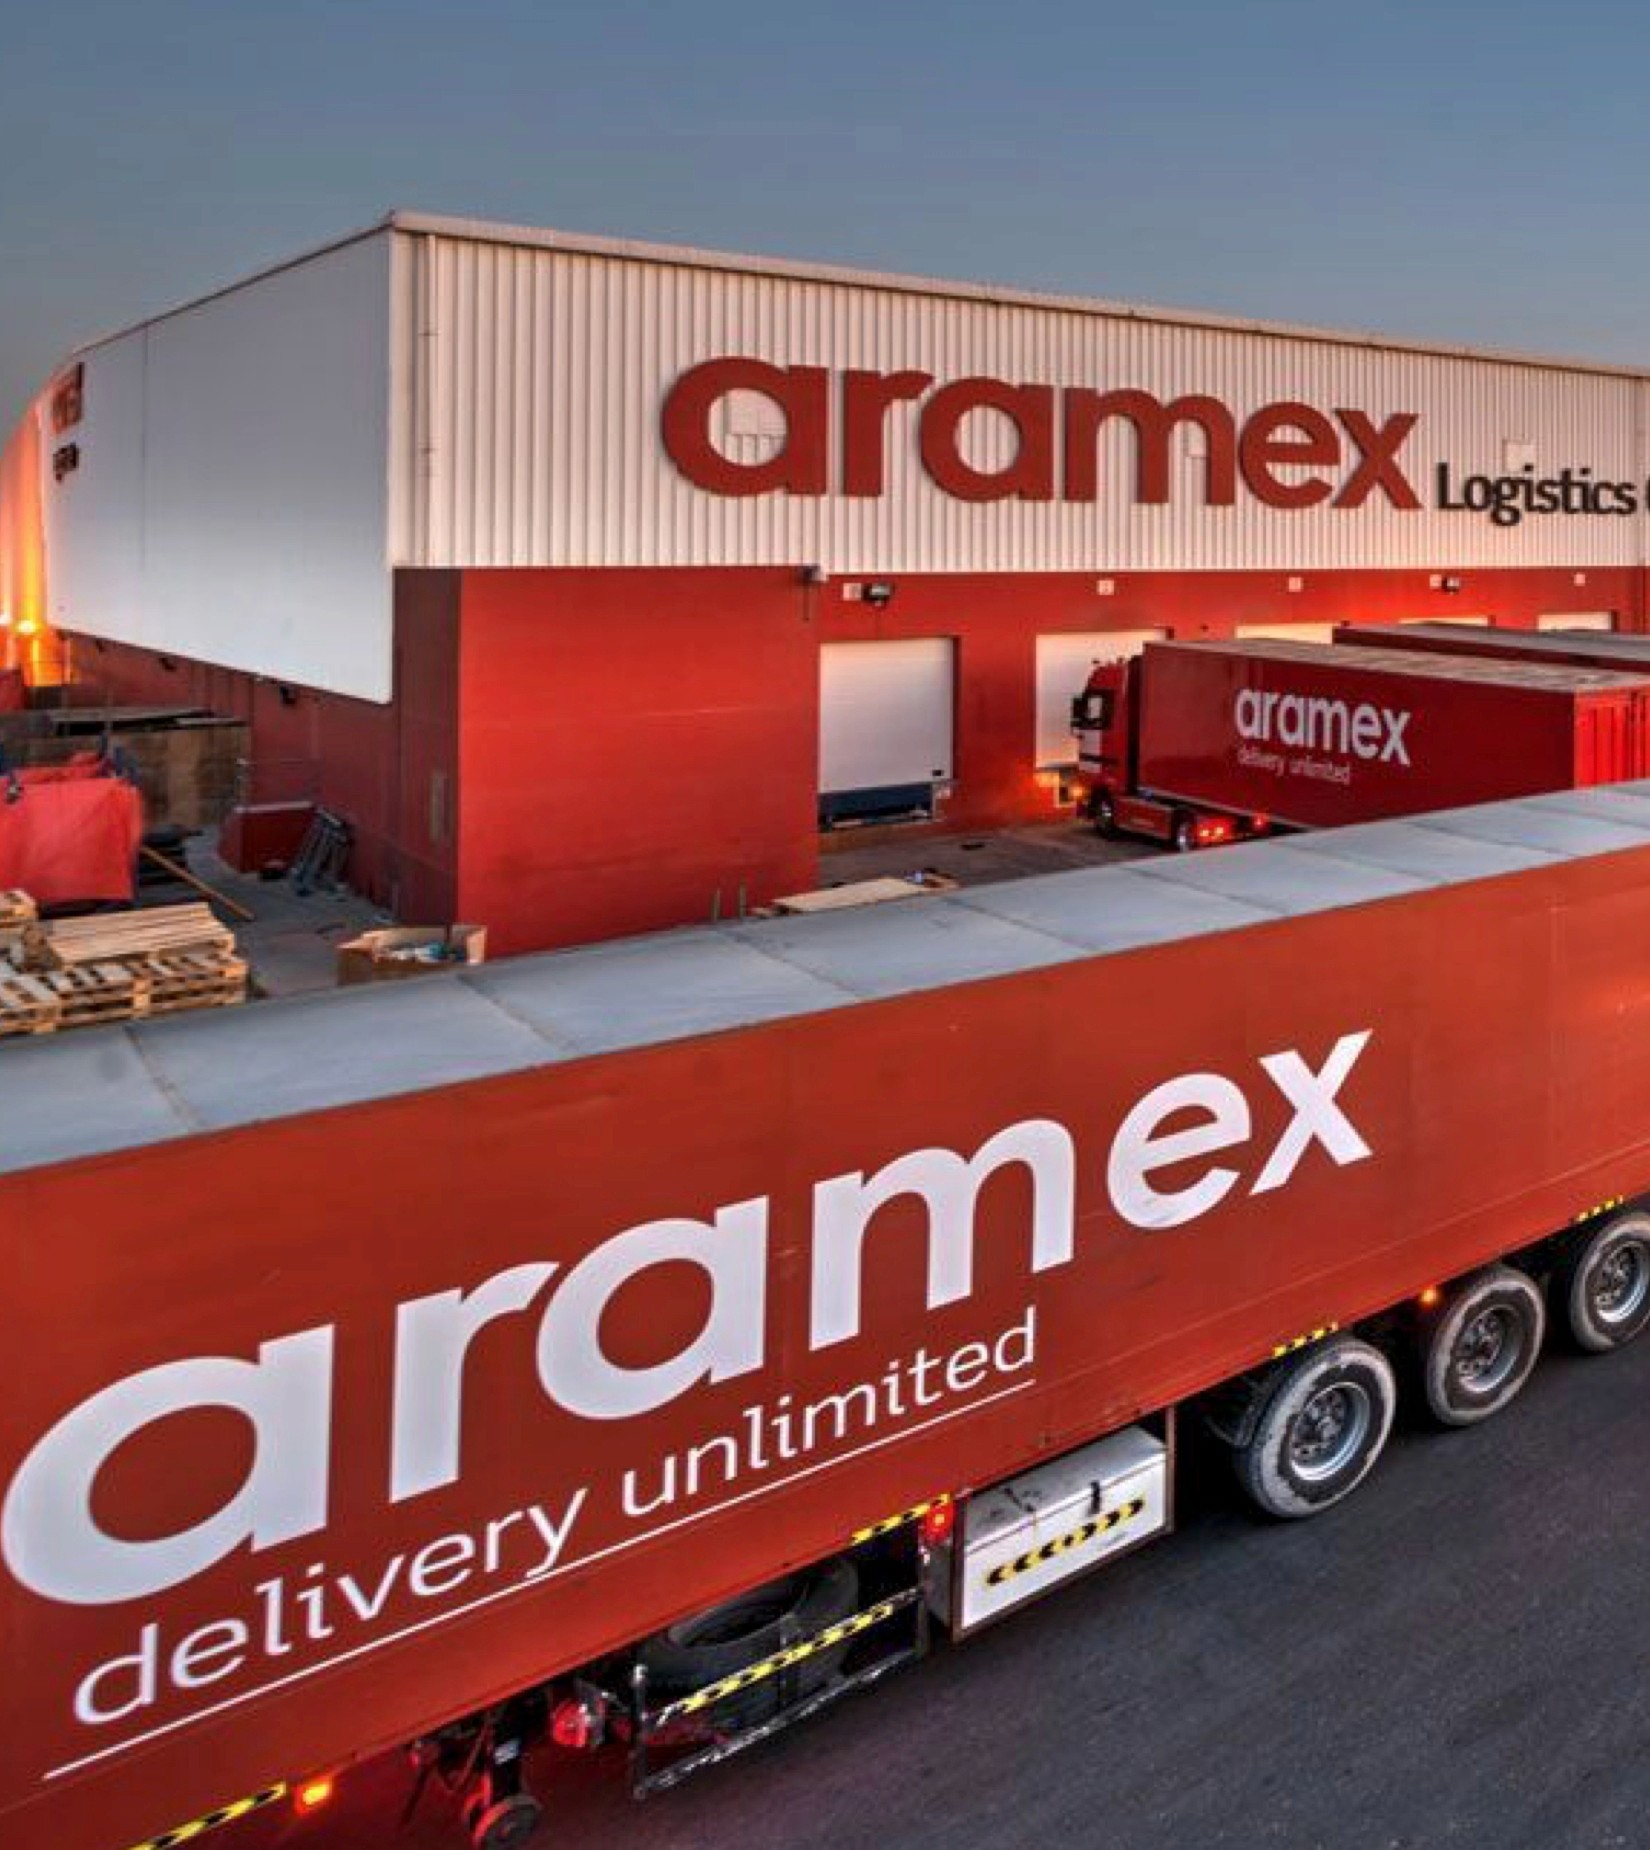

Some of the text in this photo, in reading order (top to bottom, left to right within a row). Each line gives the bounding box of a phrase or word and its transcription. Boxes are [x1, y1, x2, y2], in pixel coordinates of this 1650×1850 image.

[664, 356, 1421, 512] aramex
[1436, 462, 1638, 527] Logistics
[1234, 688, 1411, 766] aramex
[0, 1029, 1374, 1606] aramex
[73, 1305, 1037, 1726] delivery unlimited
